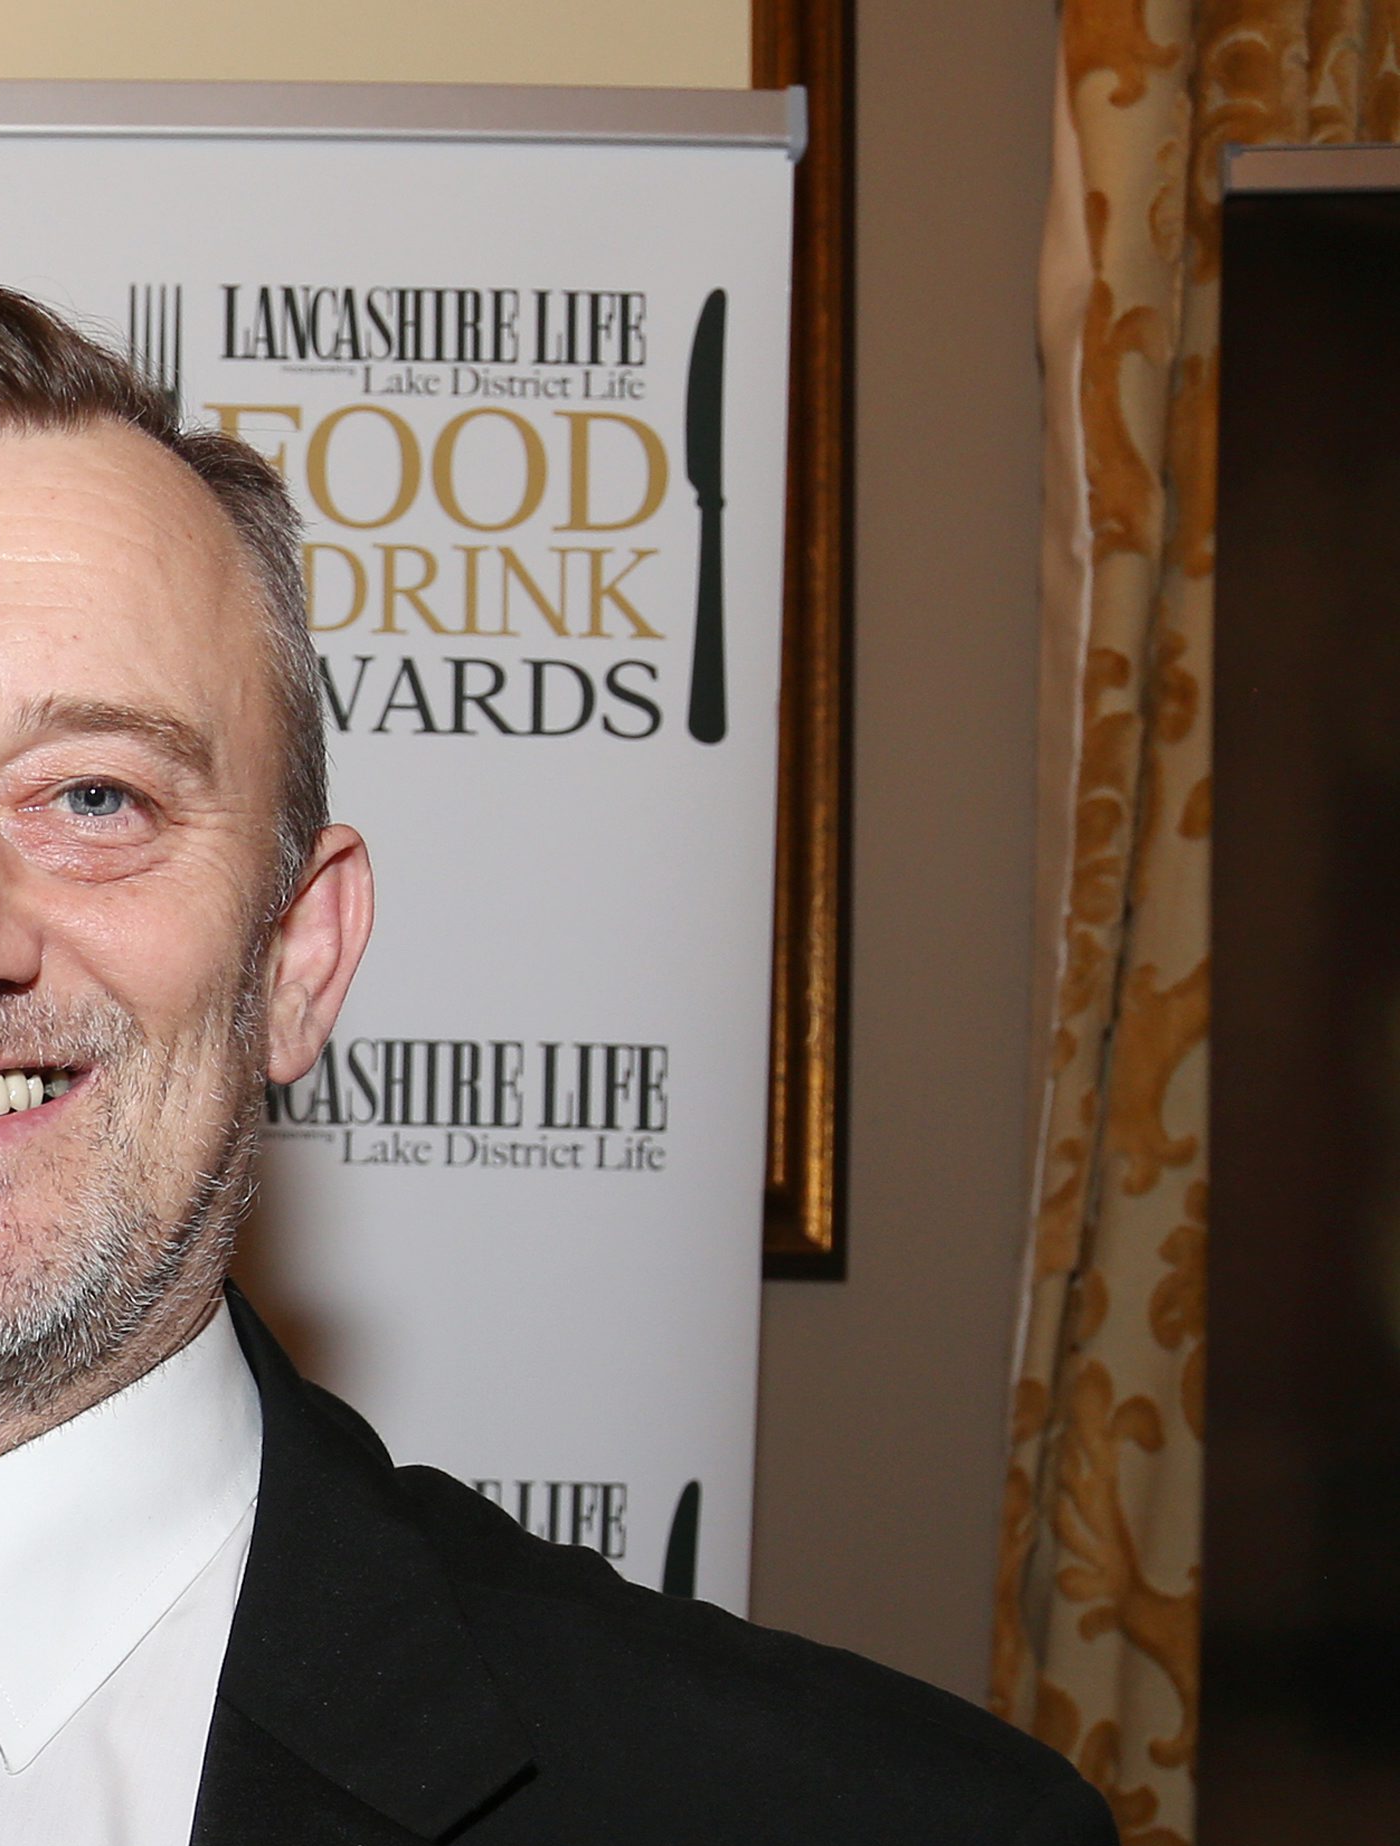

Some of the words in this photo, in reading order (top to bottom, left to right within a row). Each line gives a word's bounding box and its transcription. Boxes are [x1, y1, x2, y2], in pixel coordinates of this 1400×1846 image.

[220, 285, 520, 365] LANCASHIRE
[532, 290, 646, 367] LIFE
[361, 364, 441, 396] Lake
[451, 366, 571, 400] District
[582, 367, 645, 400] Life
[300, 543, 666, 639] DRINK
[537, 1041, 669, 1131] LIFE
[341, 1131, 432, 1166] Lake
[444, 1131, 583, 1170] District
[594, 1133, 666, 1172] Life
[515, 1479, 627, 1559] LIFE
